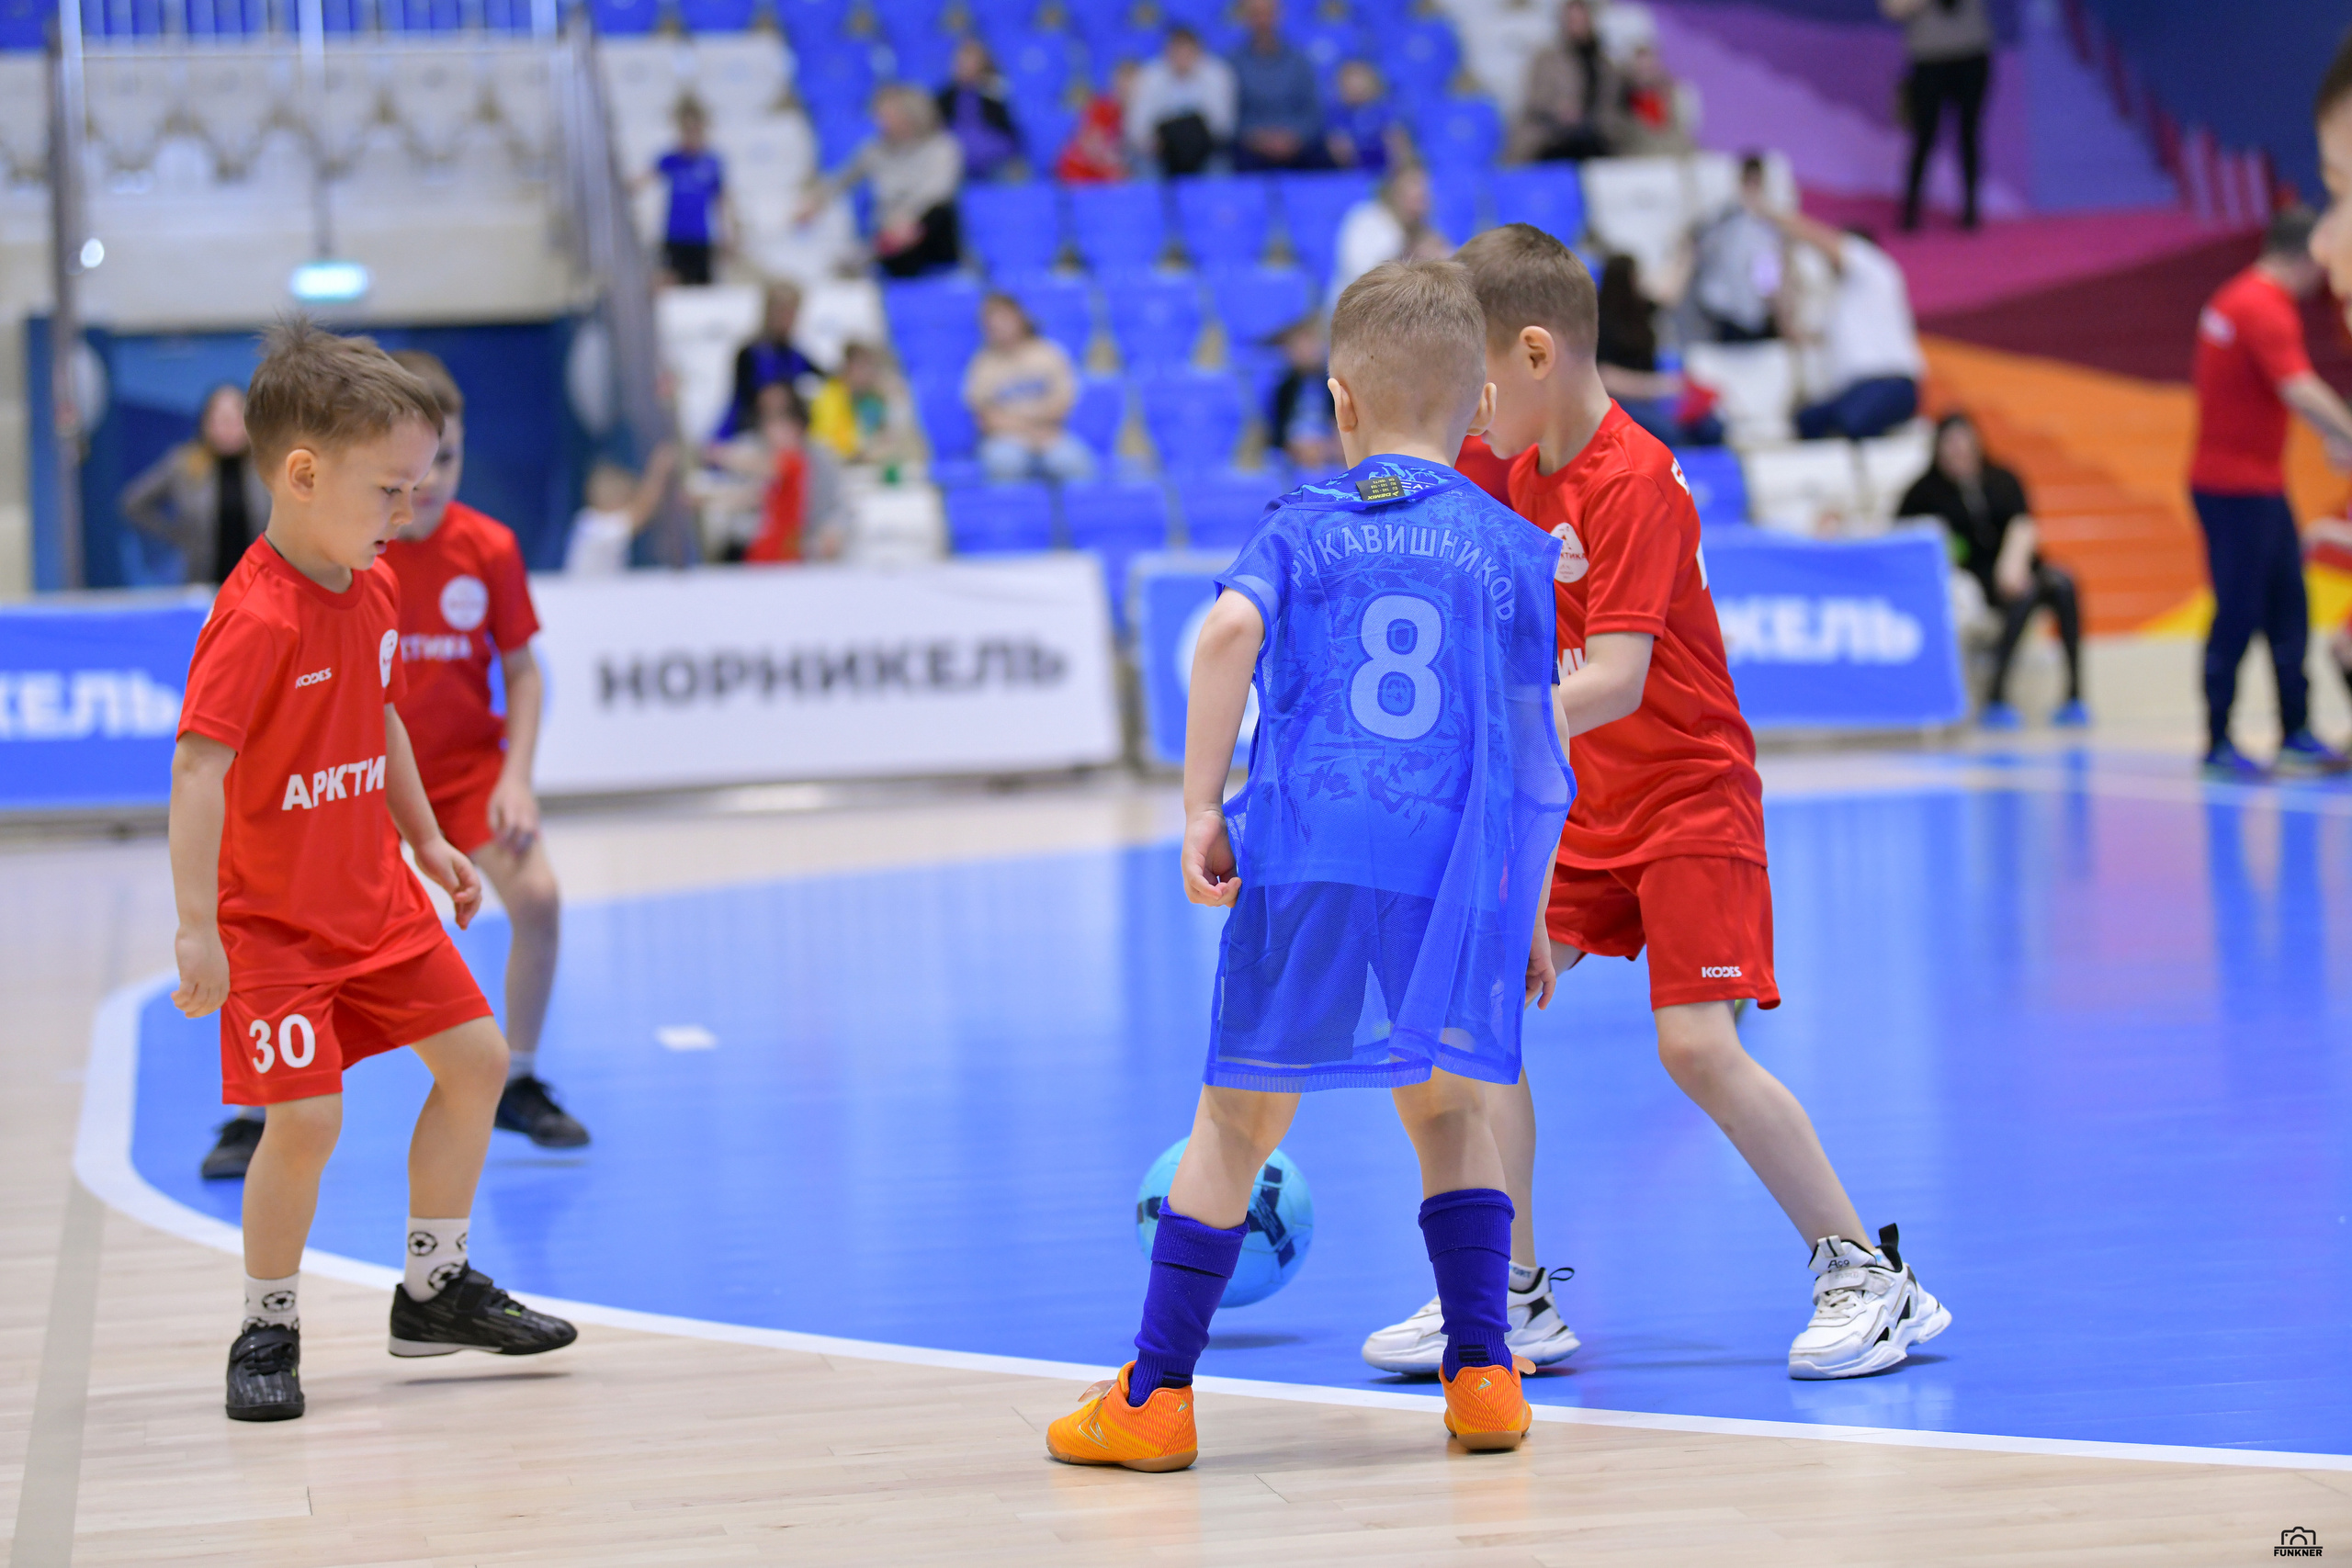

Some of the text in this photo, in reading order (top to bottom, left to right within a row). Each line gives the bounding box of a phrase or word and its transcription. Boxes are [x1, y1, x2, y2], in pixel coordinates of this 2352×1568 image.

[1367, 491, 1392, 501] DEMIX
[295, 667, 333, 689] KODES
[595, 634, 1068, 715] НОРНИКЕЛЬ
[1349, 593, 1443, 741] 8
[1701, 965, 1743, 978] KODES
[248, 1013, 316, 1075] 30
